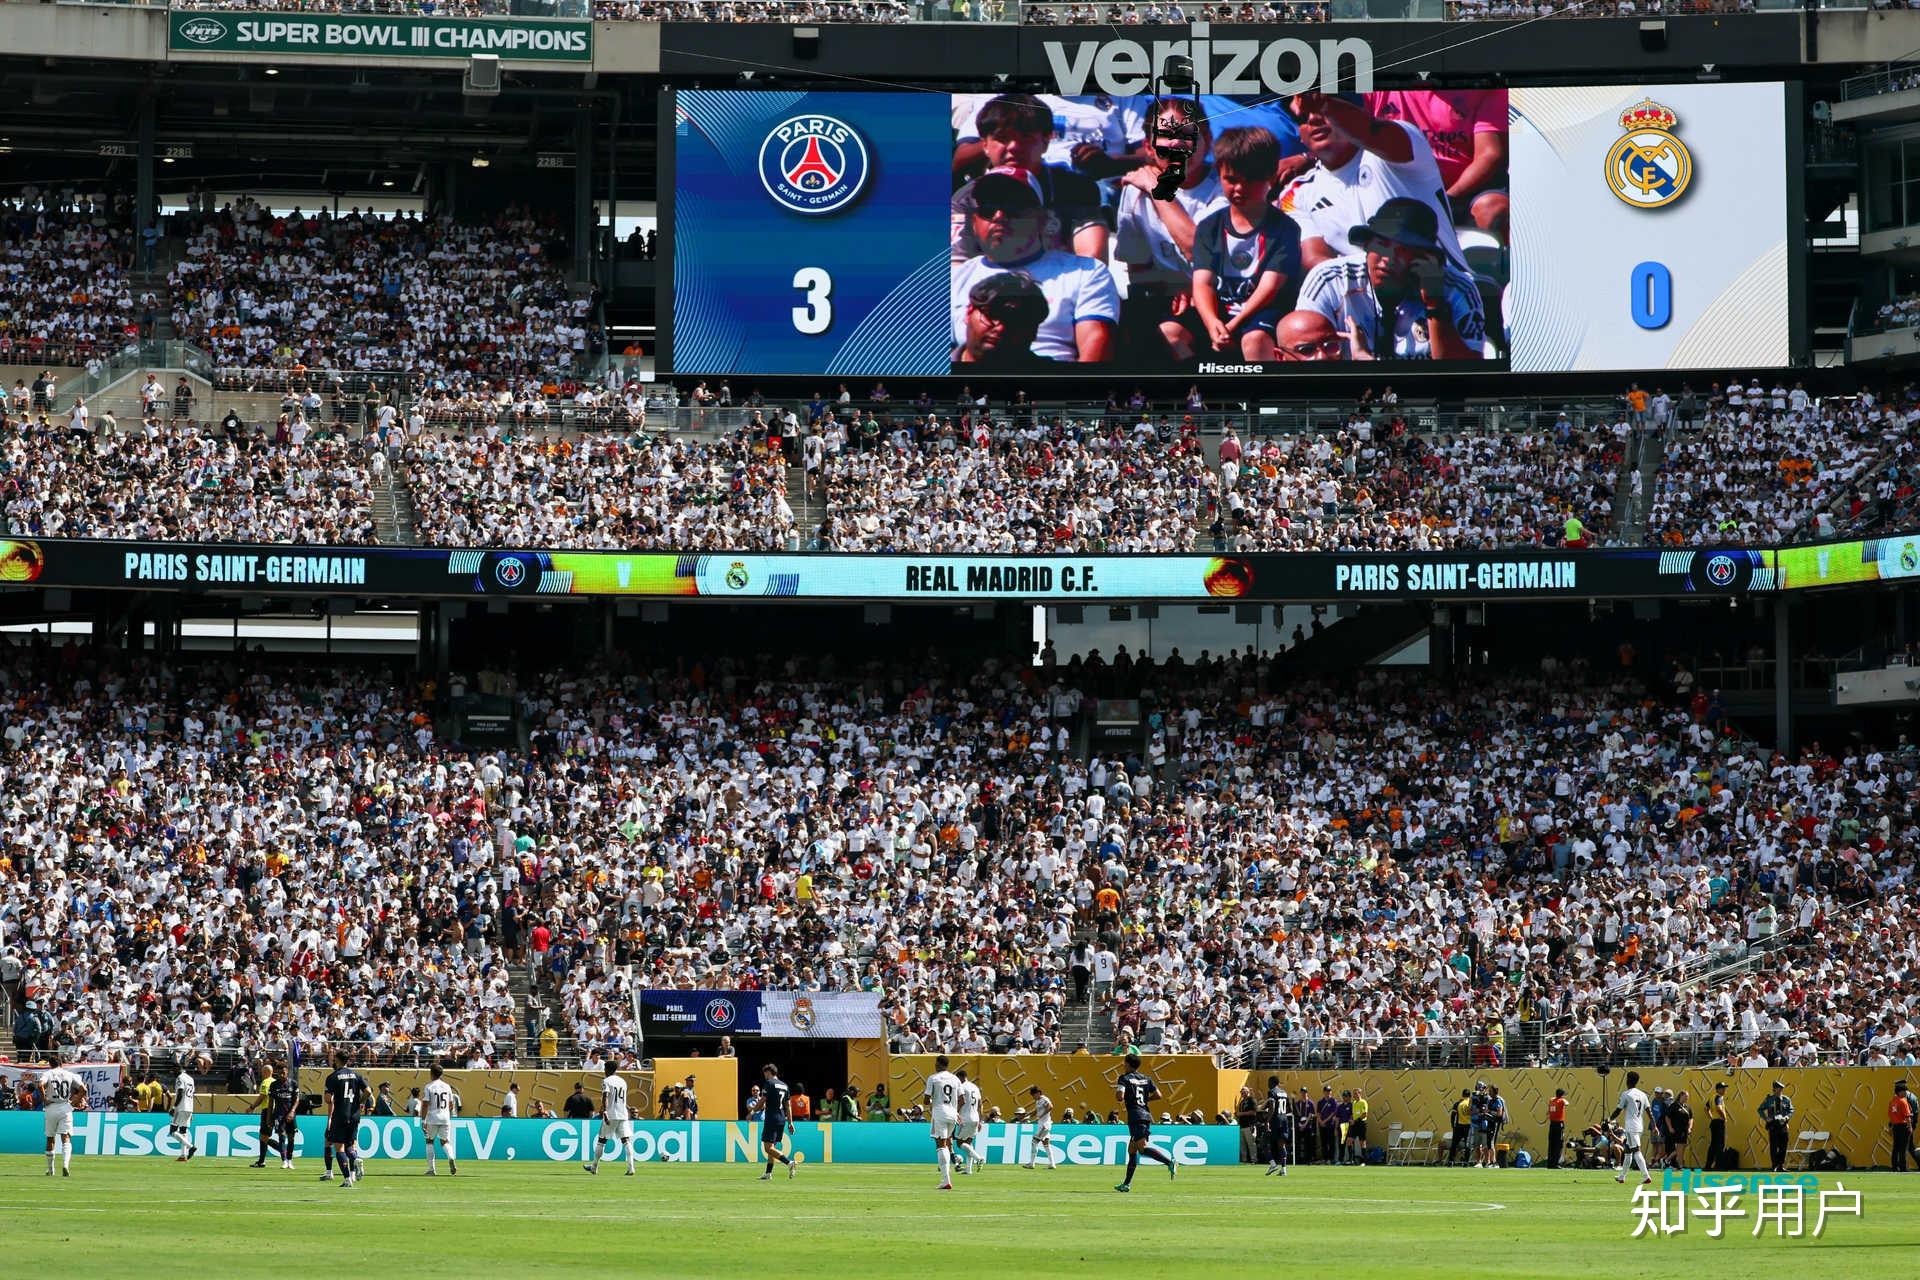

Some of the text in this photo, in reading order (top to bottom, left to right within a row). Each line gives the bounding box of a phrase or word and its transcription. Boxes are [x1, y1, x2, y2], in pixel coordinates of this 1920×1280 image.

[236, 22, 586, 51] SUPER BOWL III CHAMPIONS
[1043, 21, 1374, 96] verizon
[777, 119, 848, 144] PARIS
[792, 267, 832, 335] 3
[1631, 261, 1672, 330] 0
[1198, 362, 1264, 374] Hisense
[124, 552, 366, 584] PARIS SAINT-GERMAIN
[1336, 560, 1576, 592] PARIS SAINT-GERMAIN
[906, 566, 1098, 592] REAL MADRID C.F.
[652, 1013, 696, 1022] SAINT-GERMAIN
[666, 1004, 684, 1012] PARIS
[97, 1070, 110, 1082] EL
[50, 1080, 70, 1100] 30
[344, 1082, 355, 1103] 4
[613, 1086, 625, 1103] 14
[778, 1090, 786, 1110] 7
[943, 1084, 952, 1104] 9
[1136, 1086, 1146, 1106] 5
[434, 1092, 448, 1110] 15
[1278, 1098, 1287, 1114] 10
[1635, 1099, 1642, 1118] 7
[542, 1121, 700, 1163] Global
[976, 1123, 1208, 1166] Hisense
[1663, 1168, 1819, 1194] Hisense
